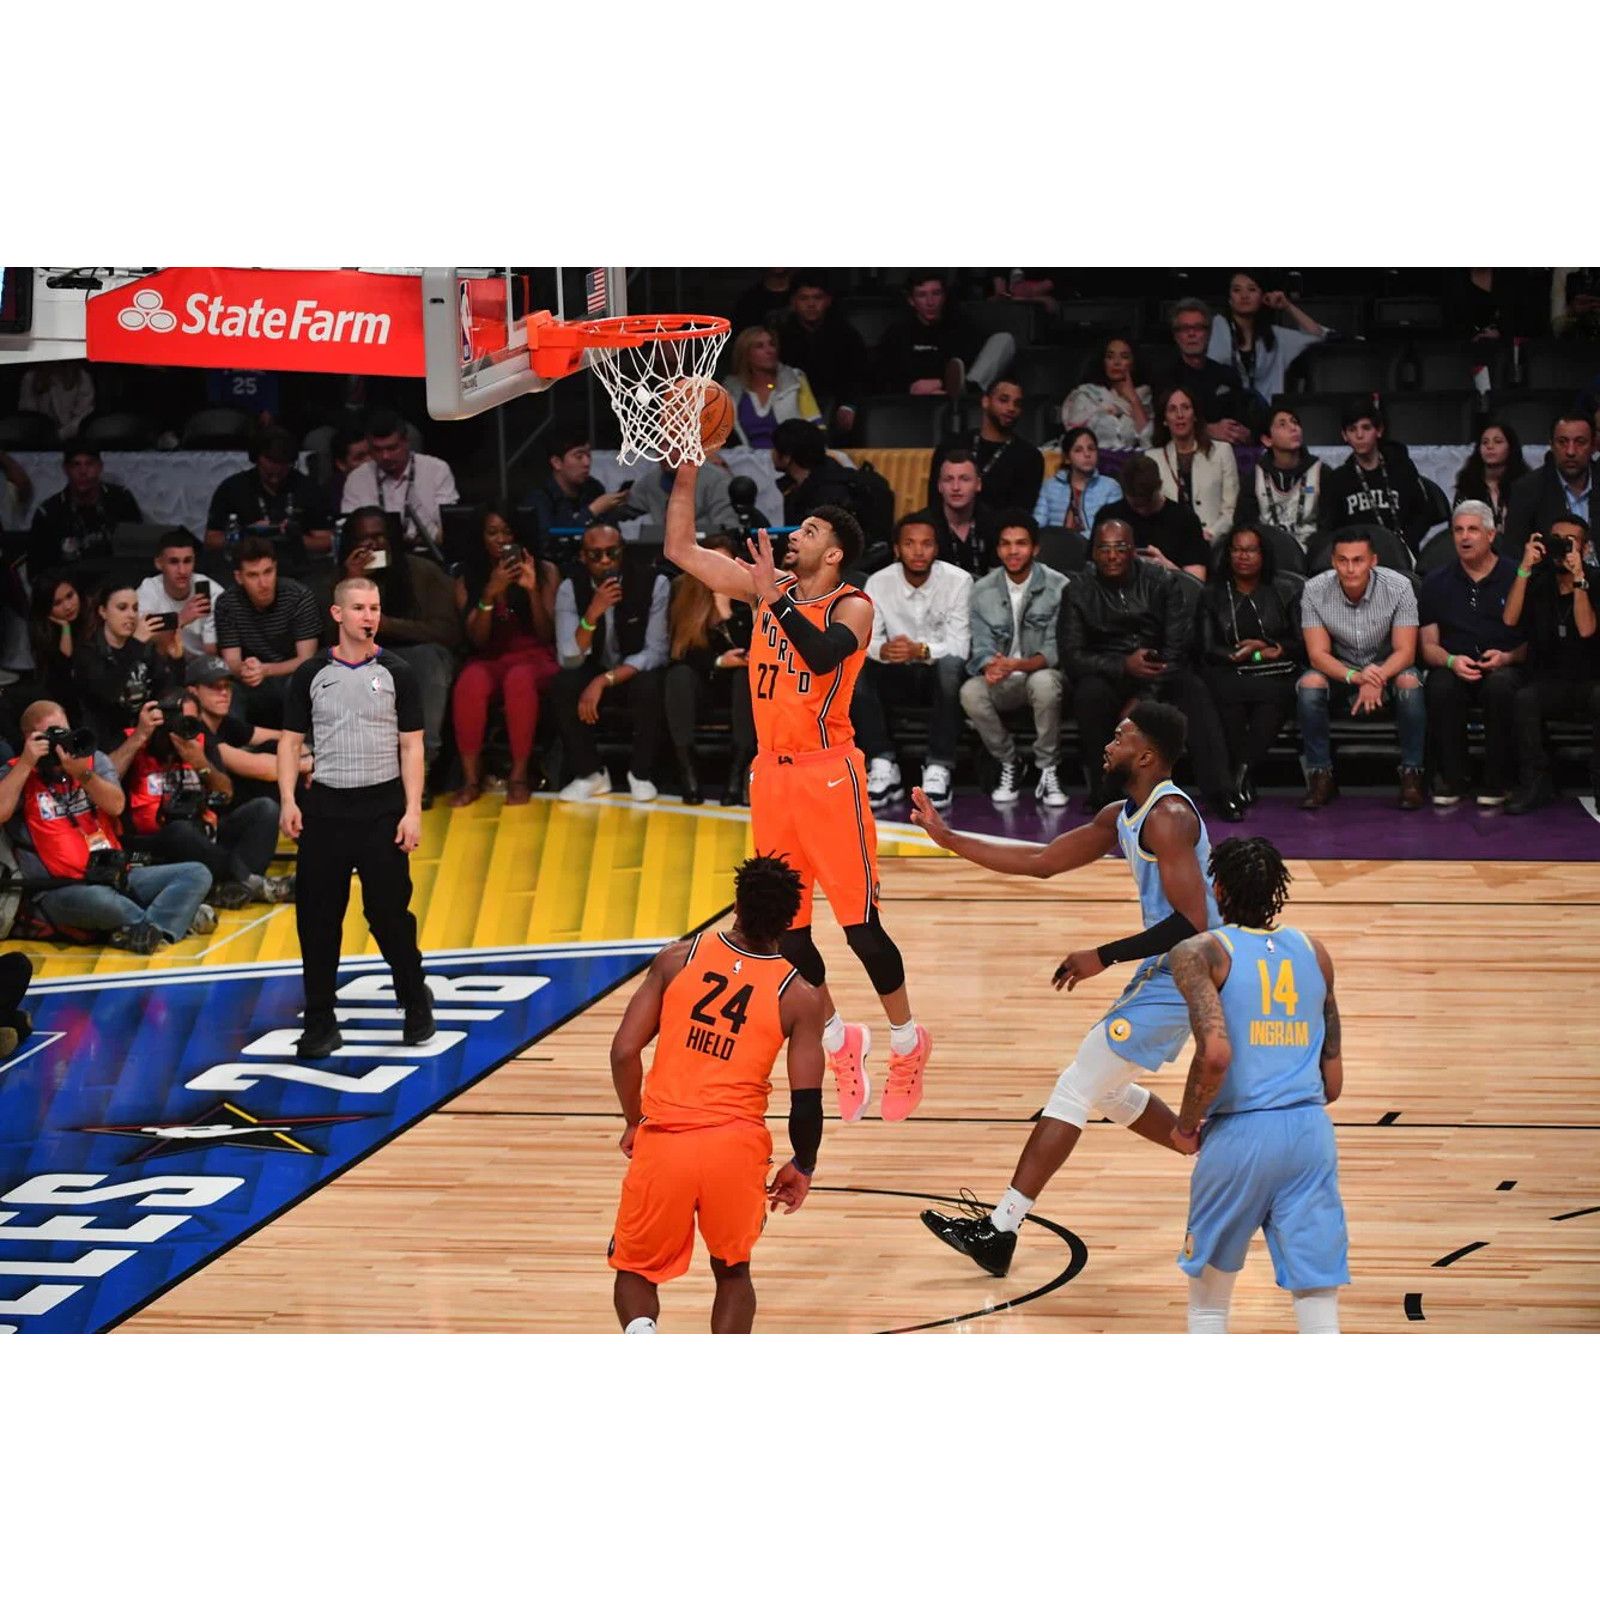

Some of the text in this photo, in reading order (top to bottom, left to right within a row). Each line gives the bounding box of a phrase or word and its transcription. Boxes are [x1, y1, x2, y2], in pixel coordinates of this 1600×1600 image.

[232, 376, 258, 395] 25
[762, 610, 812, 694] WORLD
[757, 663, 780, 700] 27
[690, 971, 754, 1035] 24
[1257, 959, 1298, 1016] 14
[184, 974, 551, 1093] 2018
[685, 1025, 736, 1061] HIELD
[1248, 1020, 1309, 1047] INGRAM
